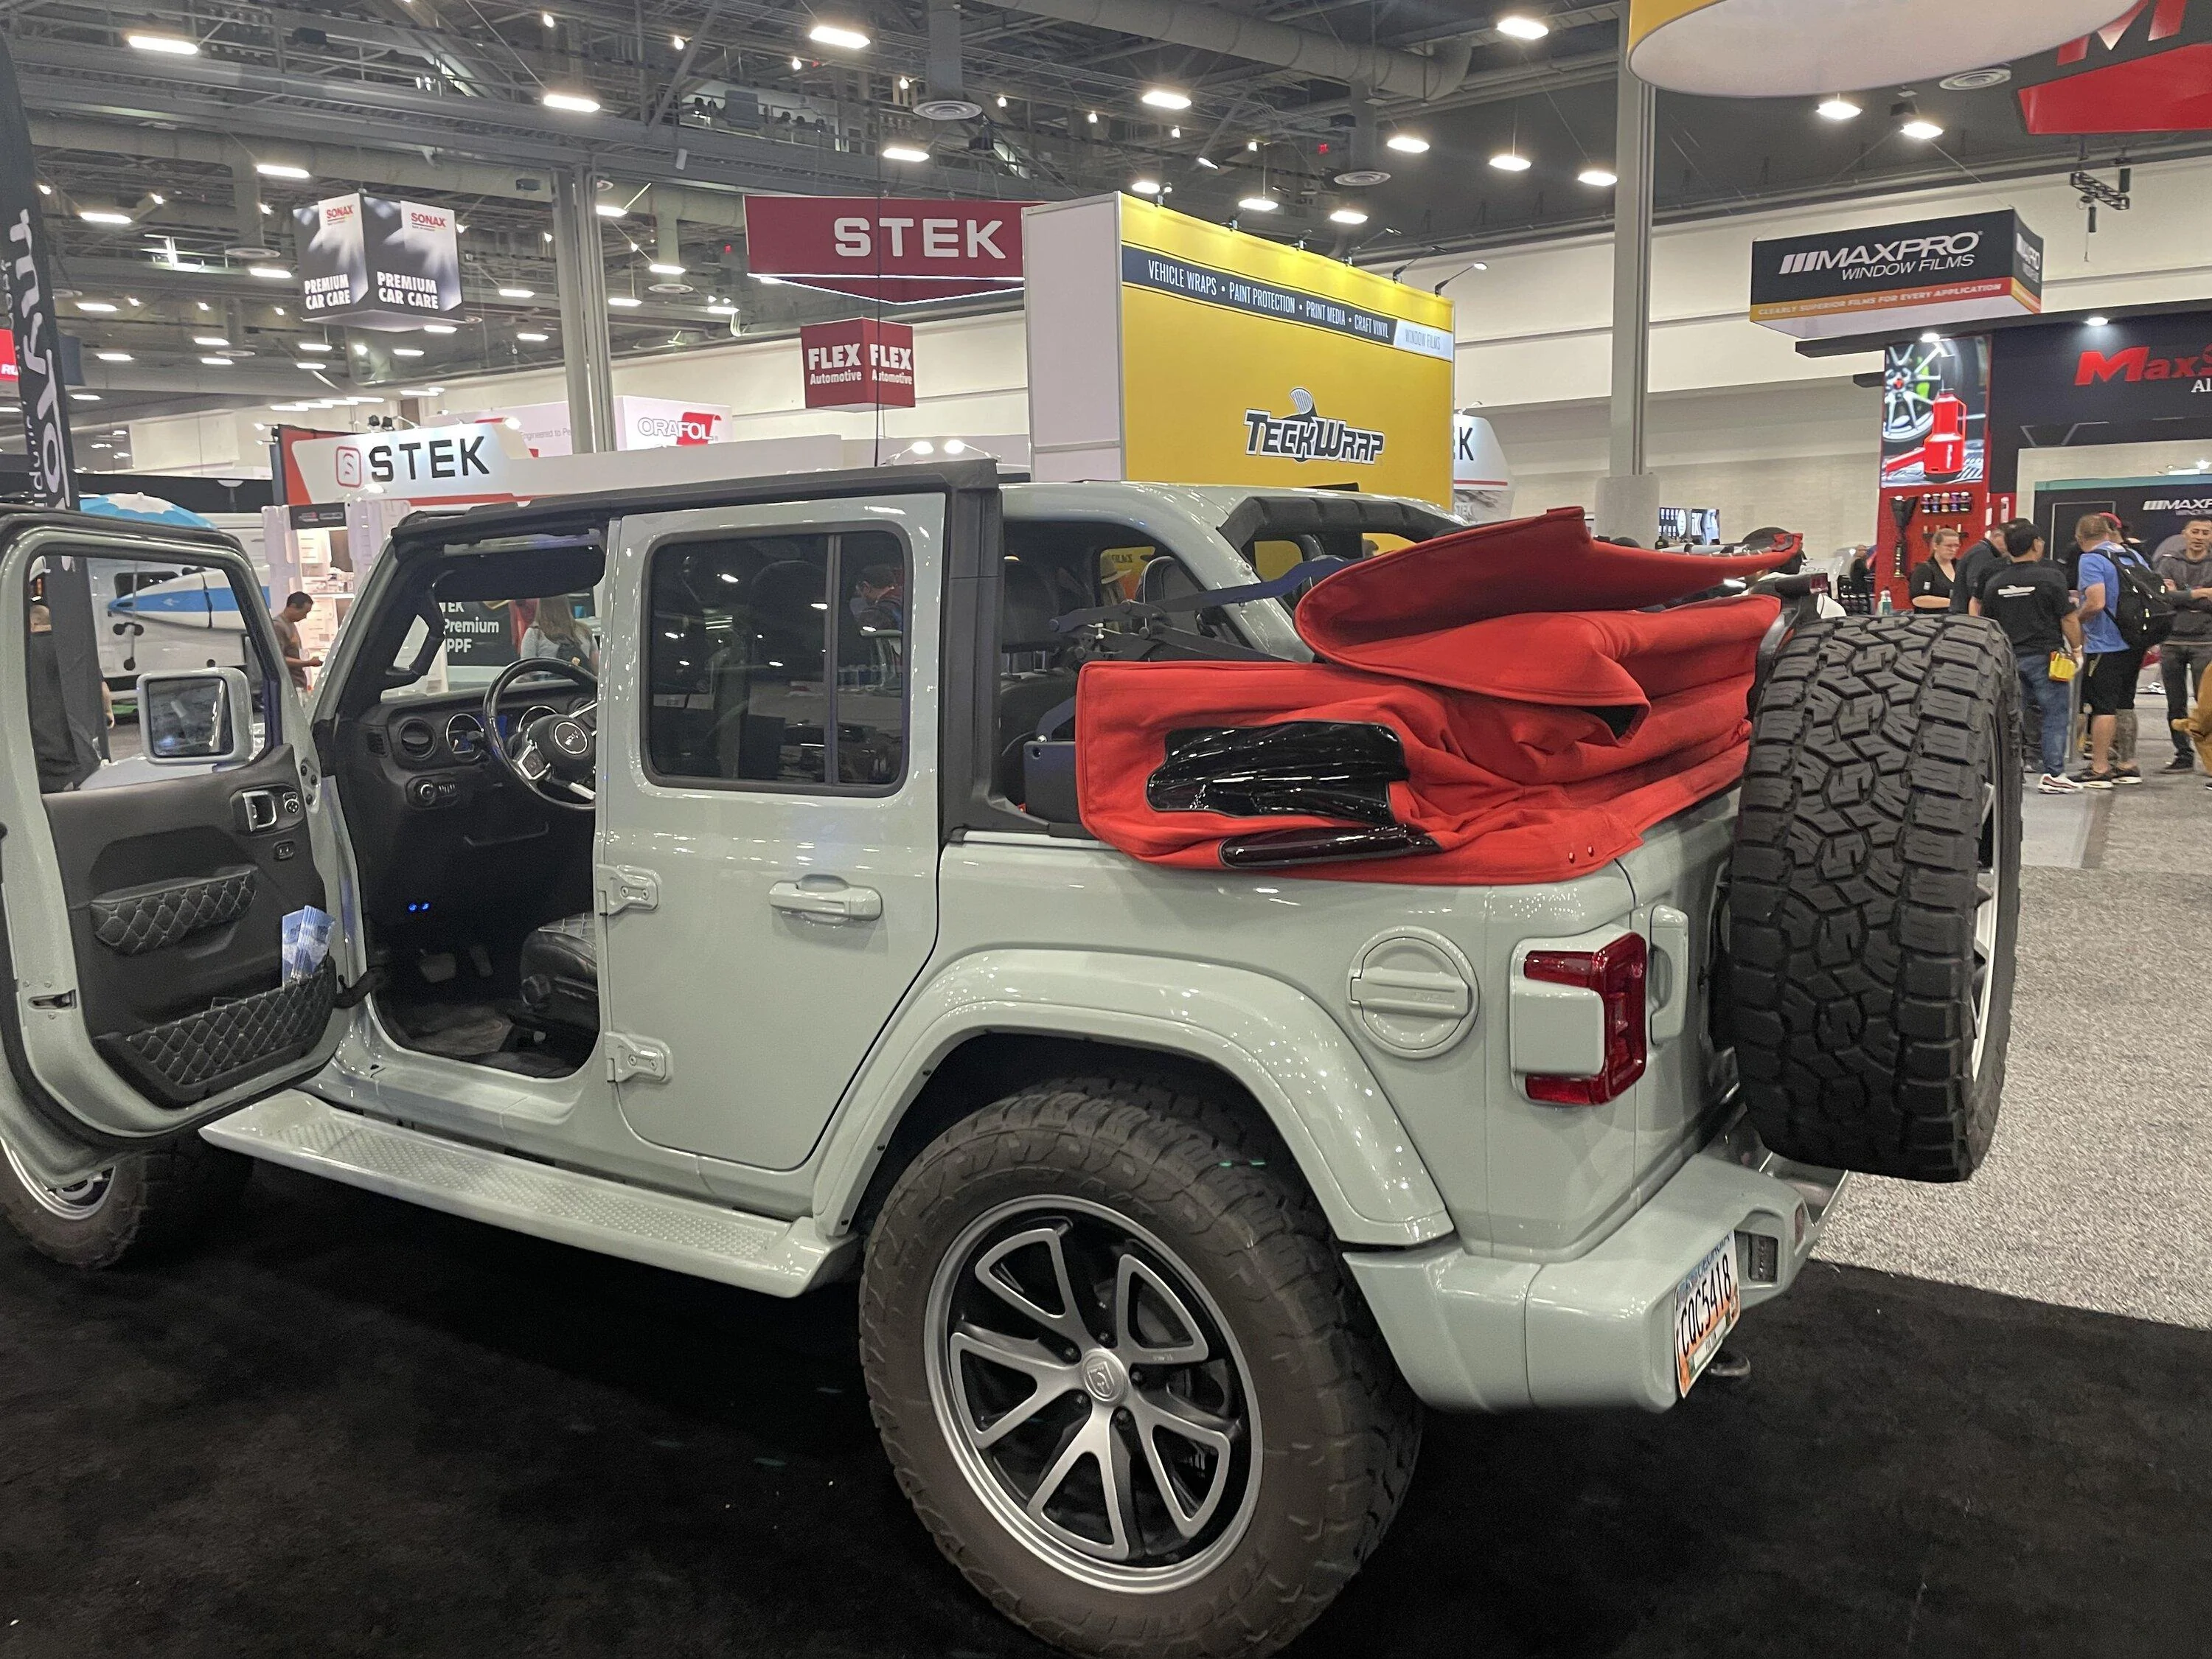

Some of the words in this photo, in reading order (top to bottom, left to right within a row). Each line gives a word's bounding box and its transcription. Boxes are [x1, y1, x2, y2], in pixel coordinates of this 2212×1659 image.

[327, 205, 353, 219] SONAX
[411, 212, 447, 228] SONAX
[834, 217, 1006, 259] STEK
[1815, 231, 1980, 271] MAXPRO
[1841, 260, 1920, 281] WINDOW
[1919, 254, 1976, 272] FILMS
[304, 274, 349, 295] PREMIUM
[376, 271, 437, 294] PREMIUM
[305, 292, 325, 310] CAR
[326, 289, 352, 307] CARE
[378, 288, 405, 305] CAR
[407, 292, 439, 310] CARE
[1147, 259, 1185, 288] VEHICLE
[1186, 271, 1217, 296] WRAPS
[1229, 281, 1251, 305] PAINT
[1253, 289, 1295, 314] PROTECTION
[1306, 300, 1326, 321] PRINT
[1326, 306, 1346, 326] MEDIA
[1354, 313, 1373, 333] CRAFT
[1373, 320, 1389, 338] VINYL
[1847, 297, 1877, 307] FILMS
[1877, 294, 1898, 303] FOR
[1899, 291, 1932, 302] EVERY
[1933, 283, 2002, 297] APPLICATION
[808, 343, 862, 370] FLEX
[869, 343, 912, 371] FLEX
[810, 369, 862, 385] Automotive
[637, 417, 714, 441] ORAFOL
[1453, 426, 1474, 461] K
[369, 436, 490, 482] STEK
[444, 616, 500, 633] Premium
[446, 638, 473, 653] PPF
[1681, 1253, 1732, 1357] CQC5418
